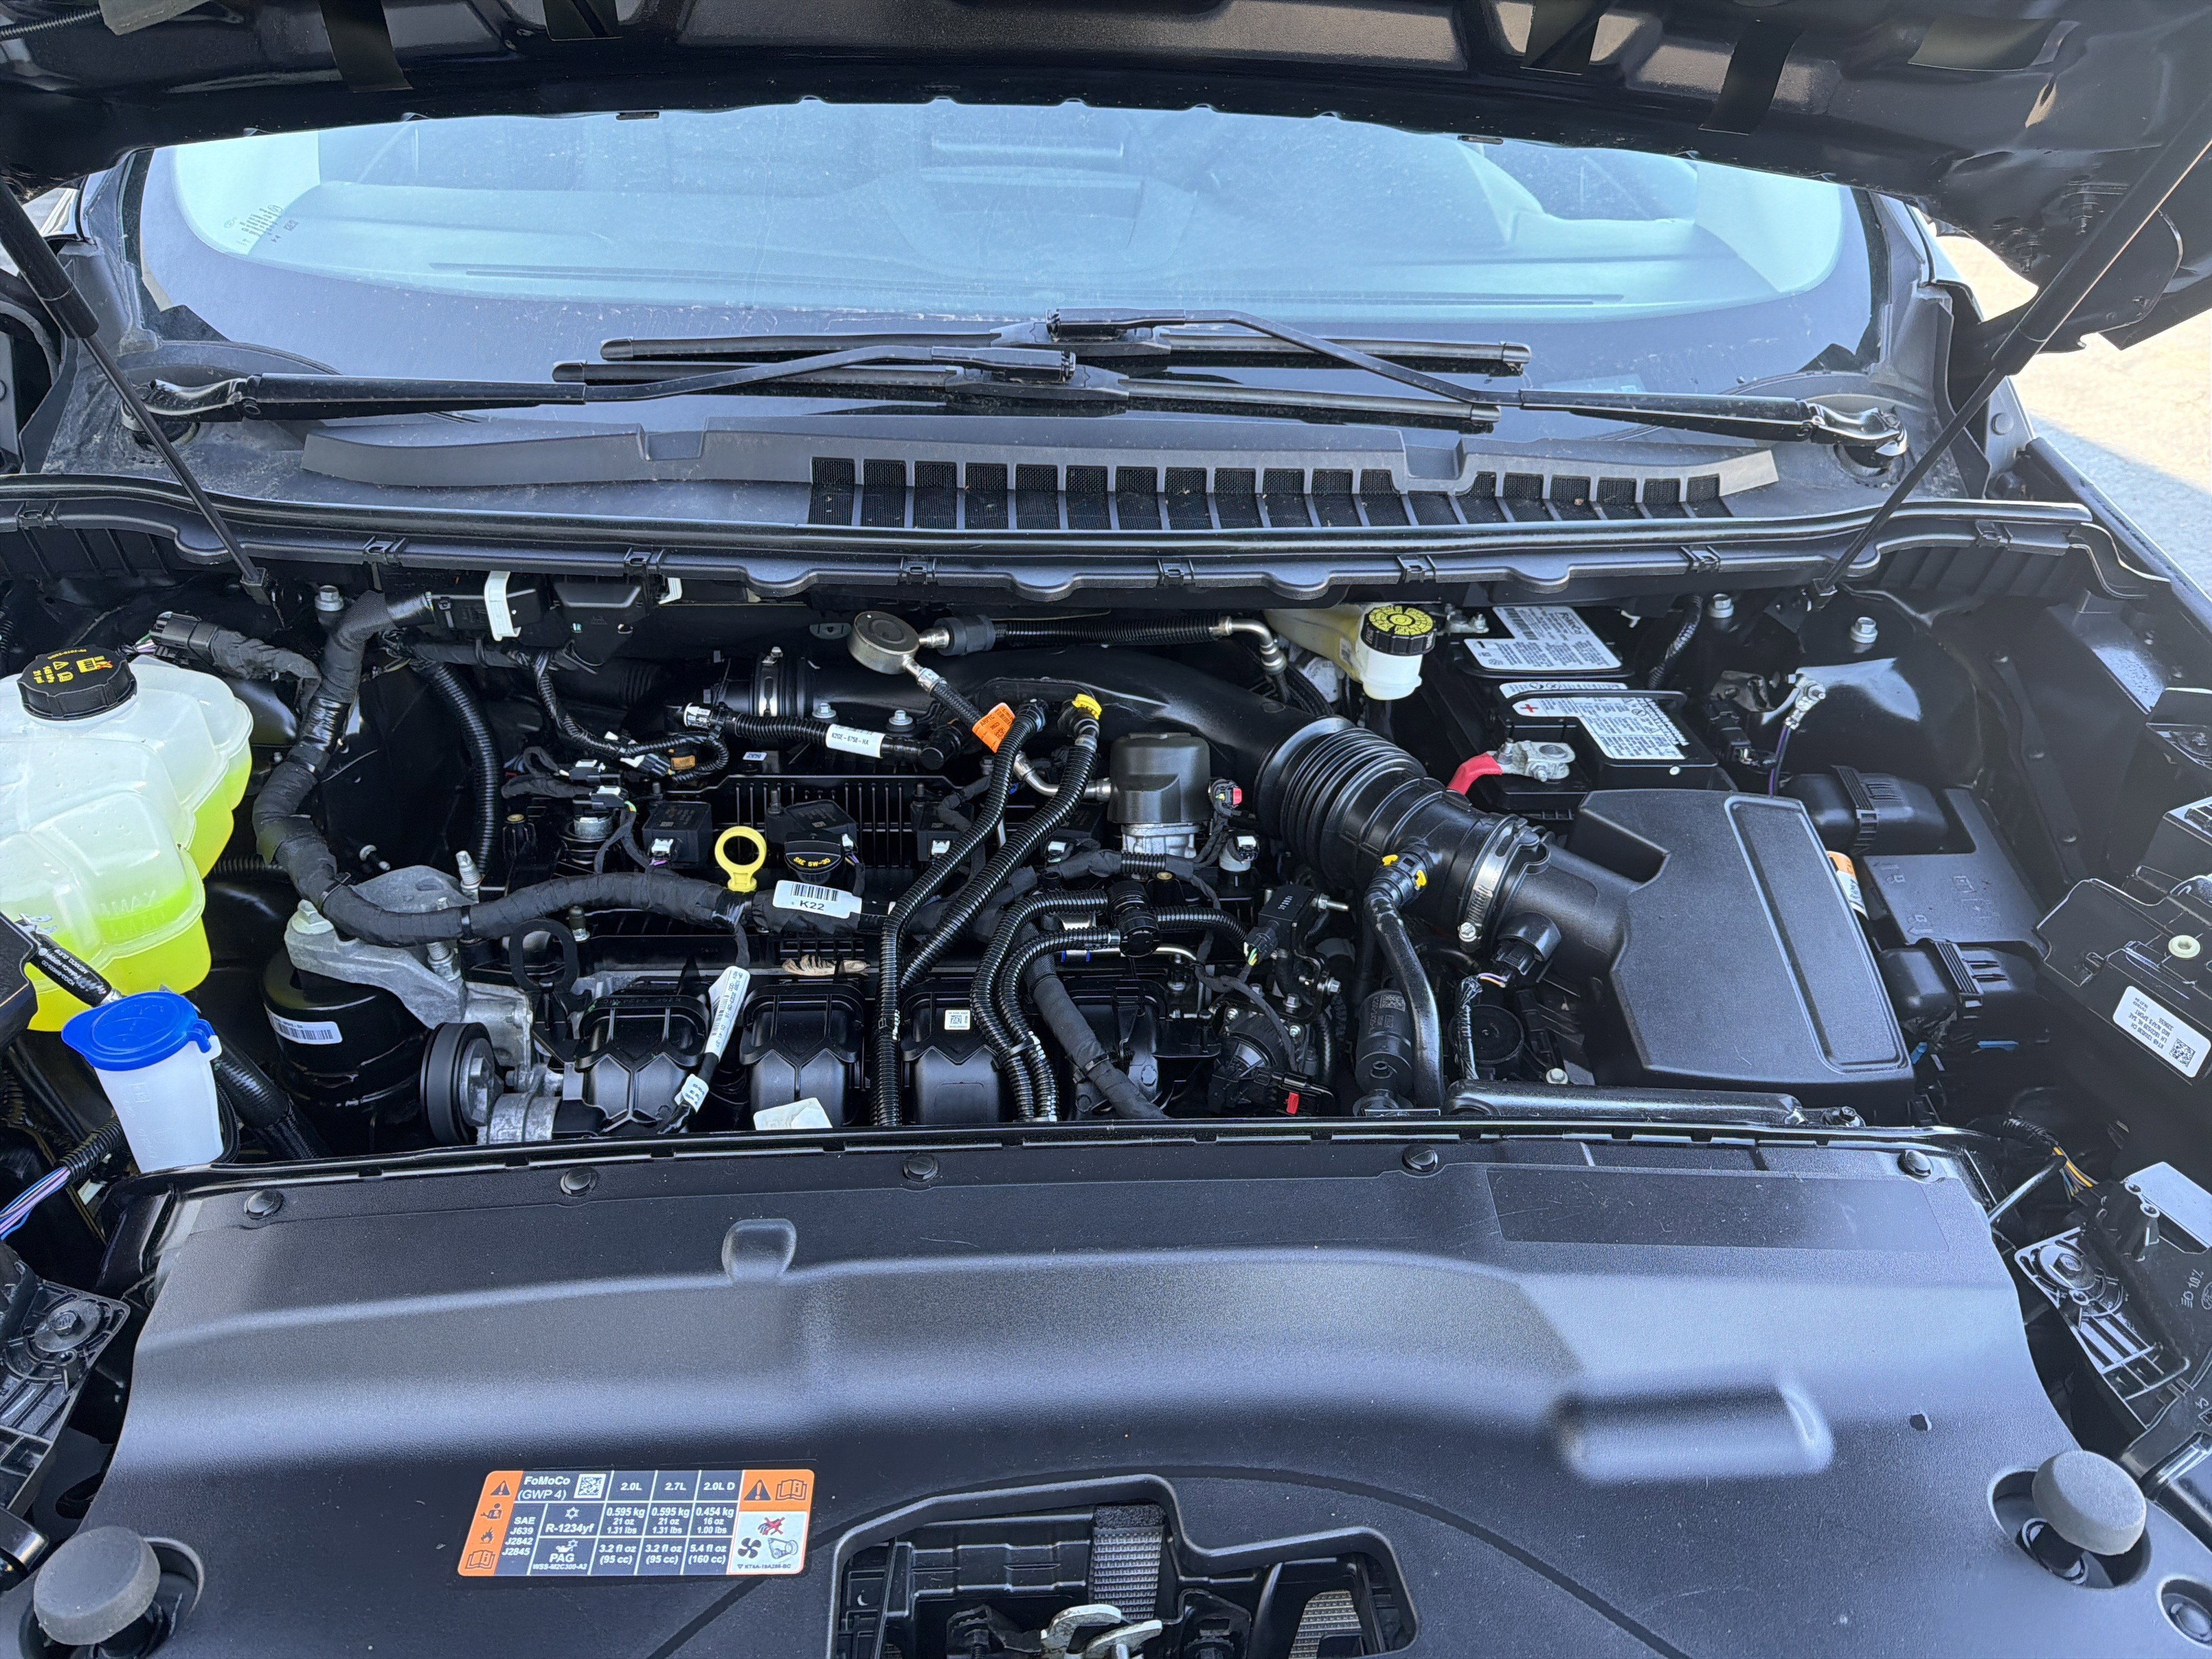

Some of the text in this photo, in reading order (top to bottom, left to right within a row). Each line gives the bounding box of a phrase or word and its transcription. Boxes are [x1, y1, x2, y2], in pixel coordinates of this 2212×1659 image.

[793, 856, 831, 867] SAE 5W-30
[799, 900, 825, 911] K22
[2128, 1012, 2137, 1022] SAE
[2134, 1008, 2149, 1022] SPORT
[523, 1476, 571, 1485] FoMoCo
[620, 1482, 642, 1491] 2.0L
[664, 1482, 686, 1491] 2.7L
[703, 1482, 735, 1491] 2.0L D
[517, 1489, 567, 1501] (GWP 4)
[606, 1507, 645, 1519] 0.595 kg
[651, 1507, 690, 1519] 0.595 kg
[696, 1507, 734, 1519] 0.454 kg
[514, 1516, 536, 1525] SAE
[510, 1527, 534, 1535] J639
[545, 1523, 595, 1534] R-1234yf
[505, 1537, 533, 1545] J2842
[501, 1547, 531, 1556] J2845
[599, 1544, 614, 1553] 3.2
[616, 1544, 623, 1553] fl
[645, 1544, 661, 1553] 3.2
[661, 1544, 669, 1553] fl
[689, 1544, 705, 1553] 5.4
[706, 1544, 713, 1553] fl
[549, 1553, 574, 1562] PAG
[600, 1555, 633, 1565] (95 cc)
[646, 1555, 679, 1565] (95 cc)
[688, 1555, 726, 1565] (160 cc)
